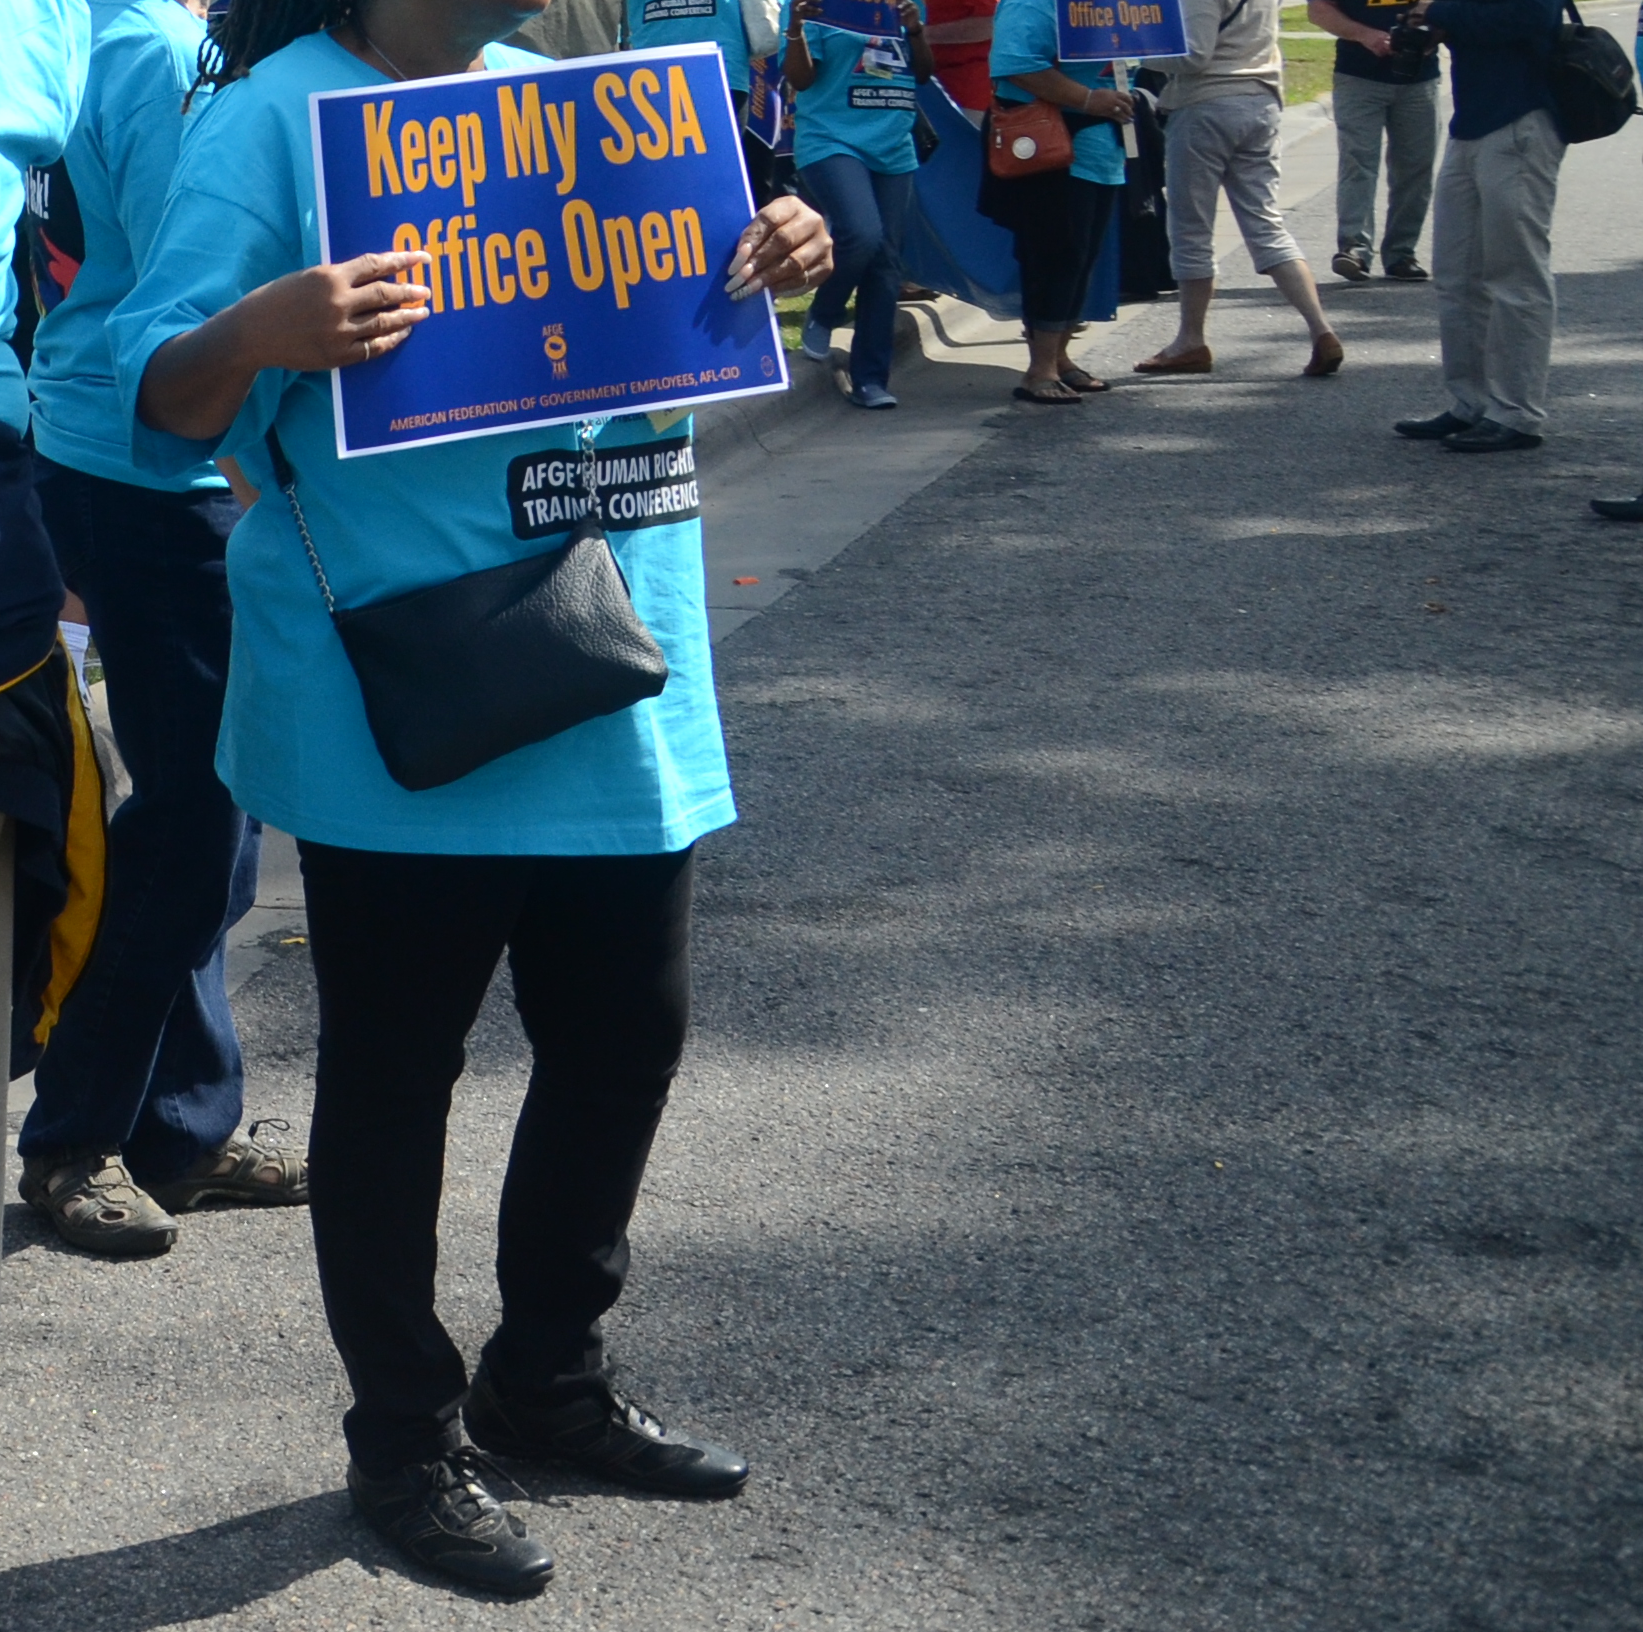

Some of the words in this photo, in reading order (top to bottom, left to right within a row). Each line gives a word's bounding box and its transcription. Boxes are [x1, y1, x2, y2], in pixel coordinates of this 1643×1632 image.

[1068, 0, 1114, 28] Office
[1117, 0, 1163, 31] Open
[362, 99, 487, 208] Keep
[496, 82, 576, 196] My
[592, 65, 707, 165] SSA
[561, 198, 707, 310] Open
[541, 322, 565, 337] AFGE
[389, 410, 447, 432] AMERICAN
[447, 398, 518, 423] FEDERATION
[519, 395, 538, 410] OF
[539, 382, 627, 408] GOVERNMENT
[629, 373, 699, 395] EMPLOYEES,
[698, 365, 741, 383] AFL-CIO
